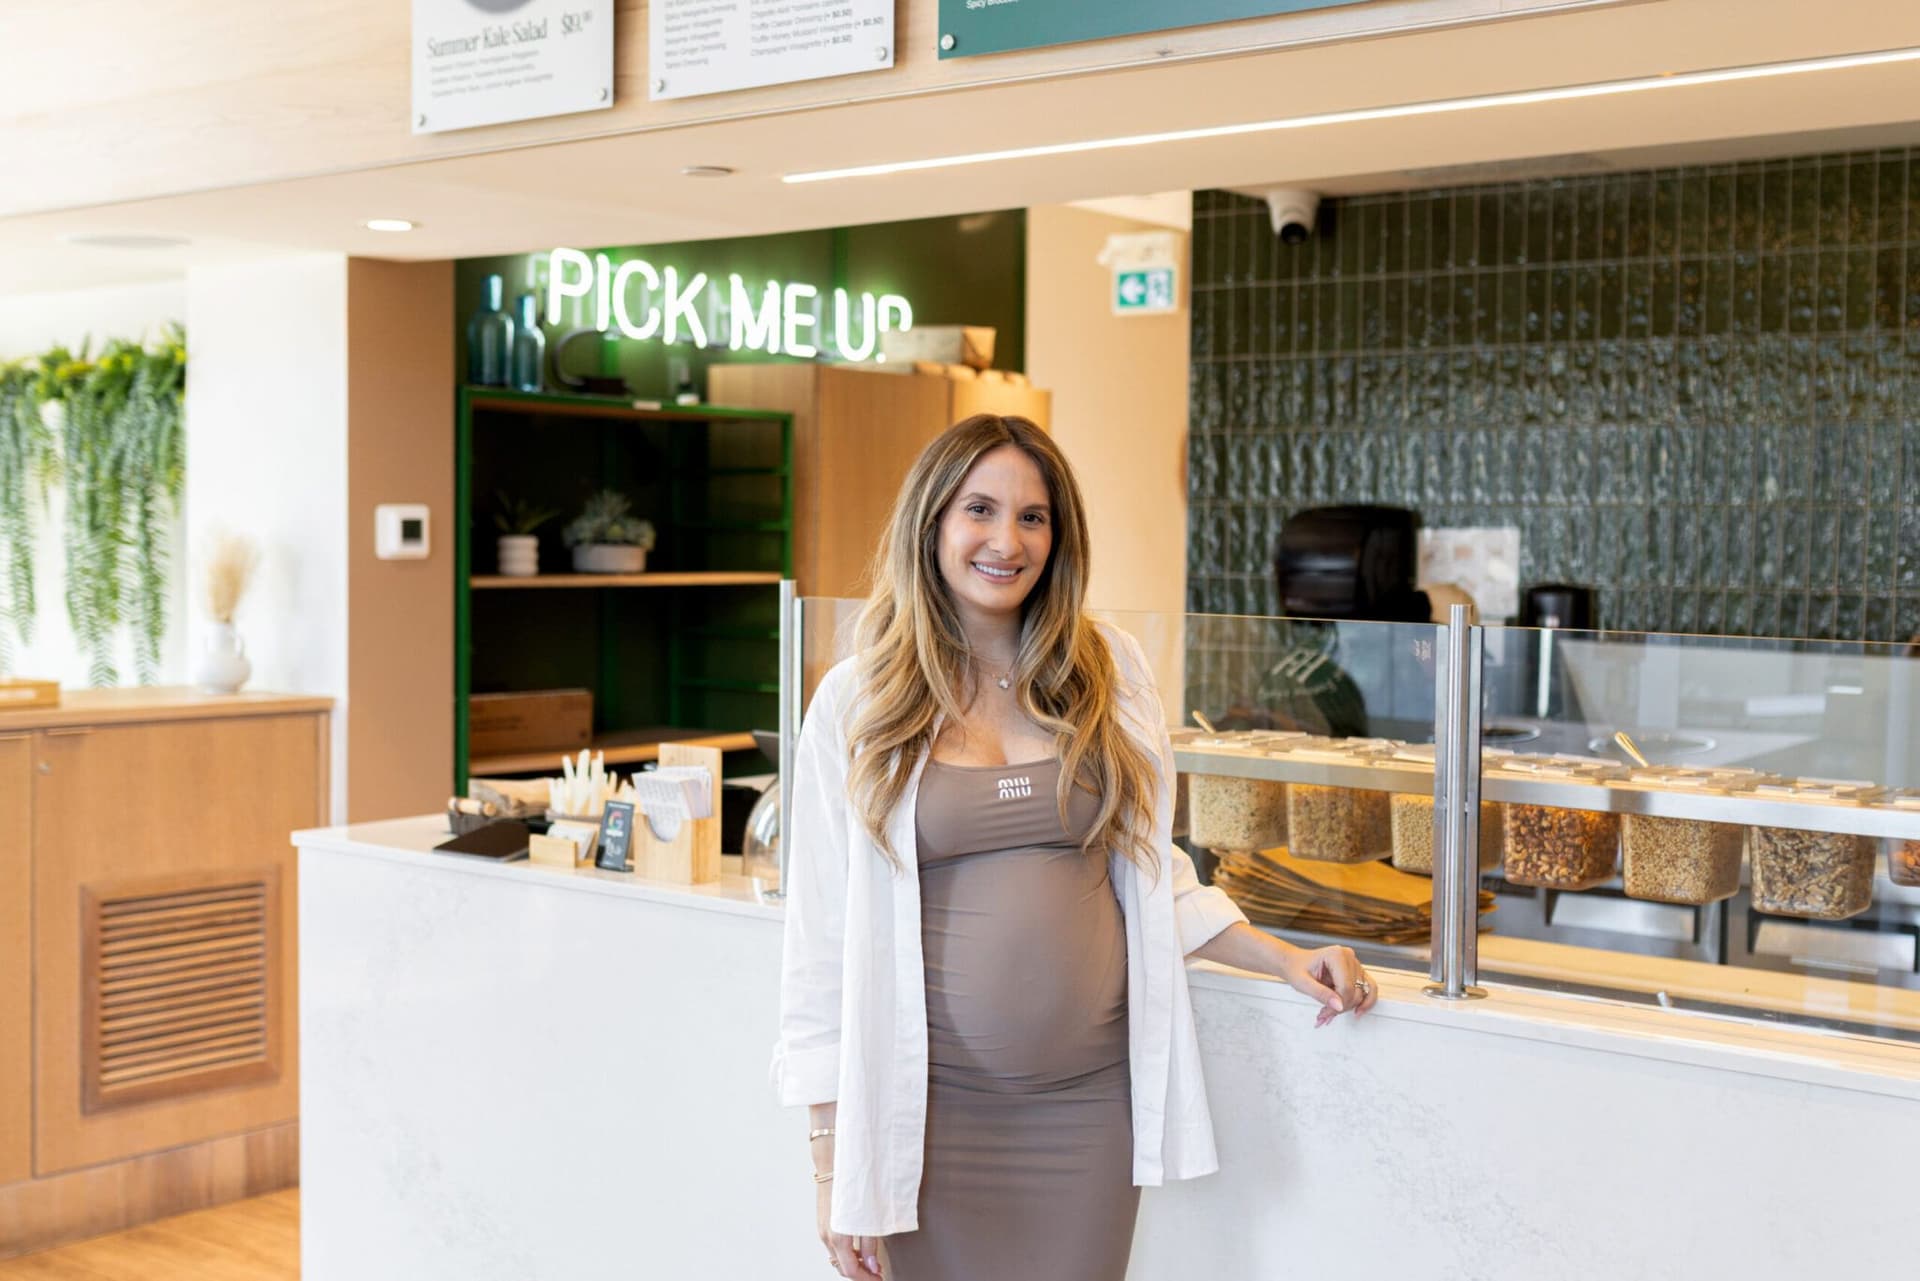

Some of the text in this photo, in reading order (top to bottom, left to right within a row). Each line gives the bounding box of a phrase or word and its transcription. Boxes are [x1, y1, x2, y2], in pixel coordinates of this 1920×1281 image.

[427, 35, 480, 58] Summer
[483, 26, 511, 49] Kale
[512, 17, 548, 44] Salad
[547, 246, 914, 364] PICK ME UP
